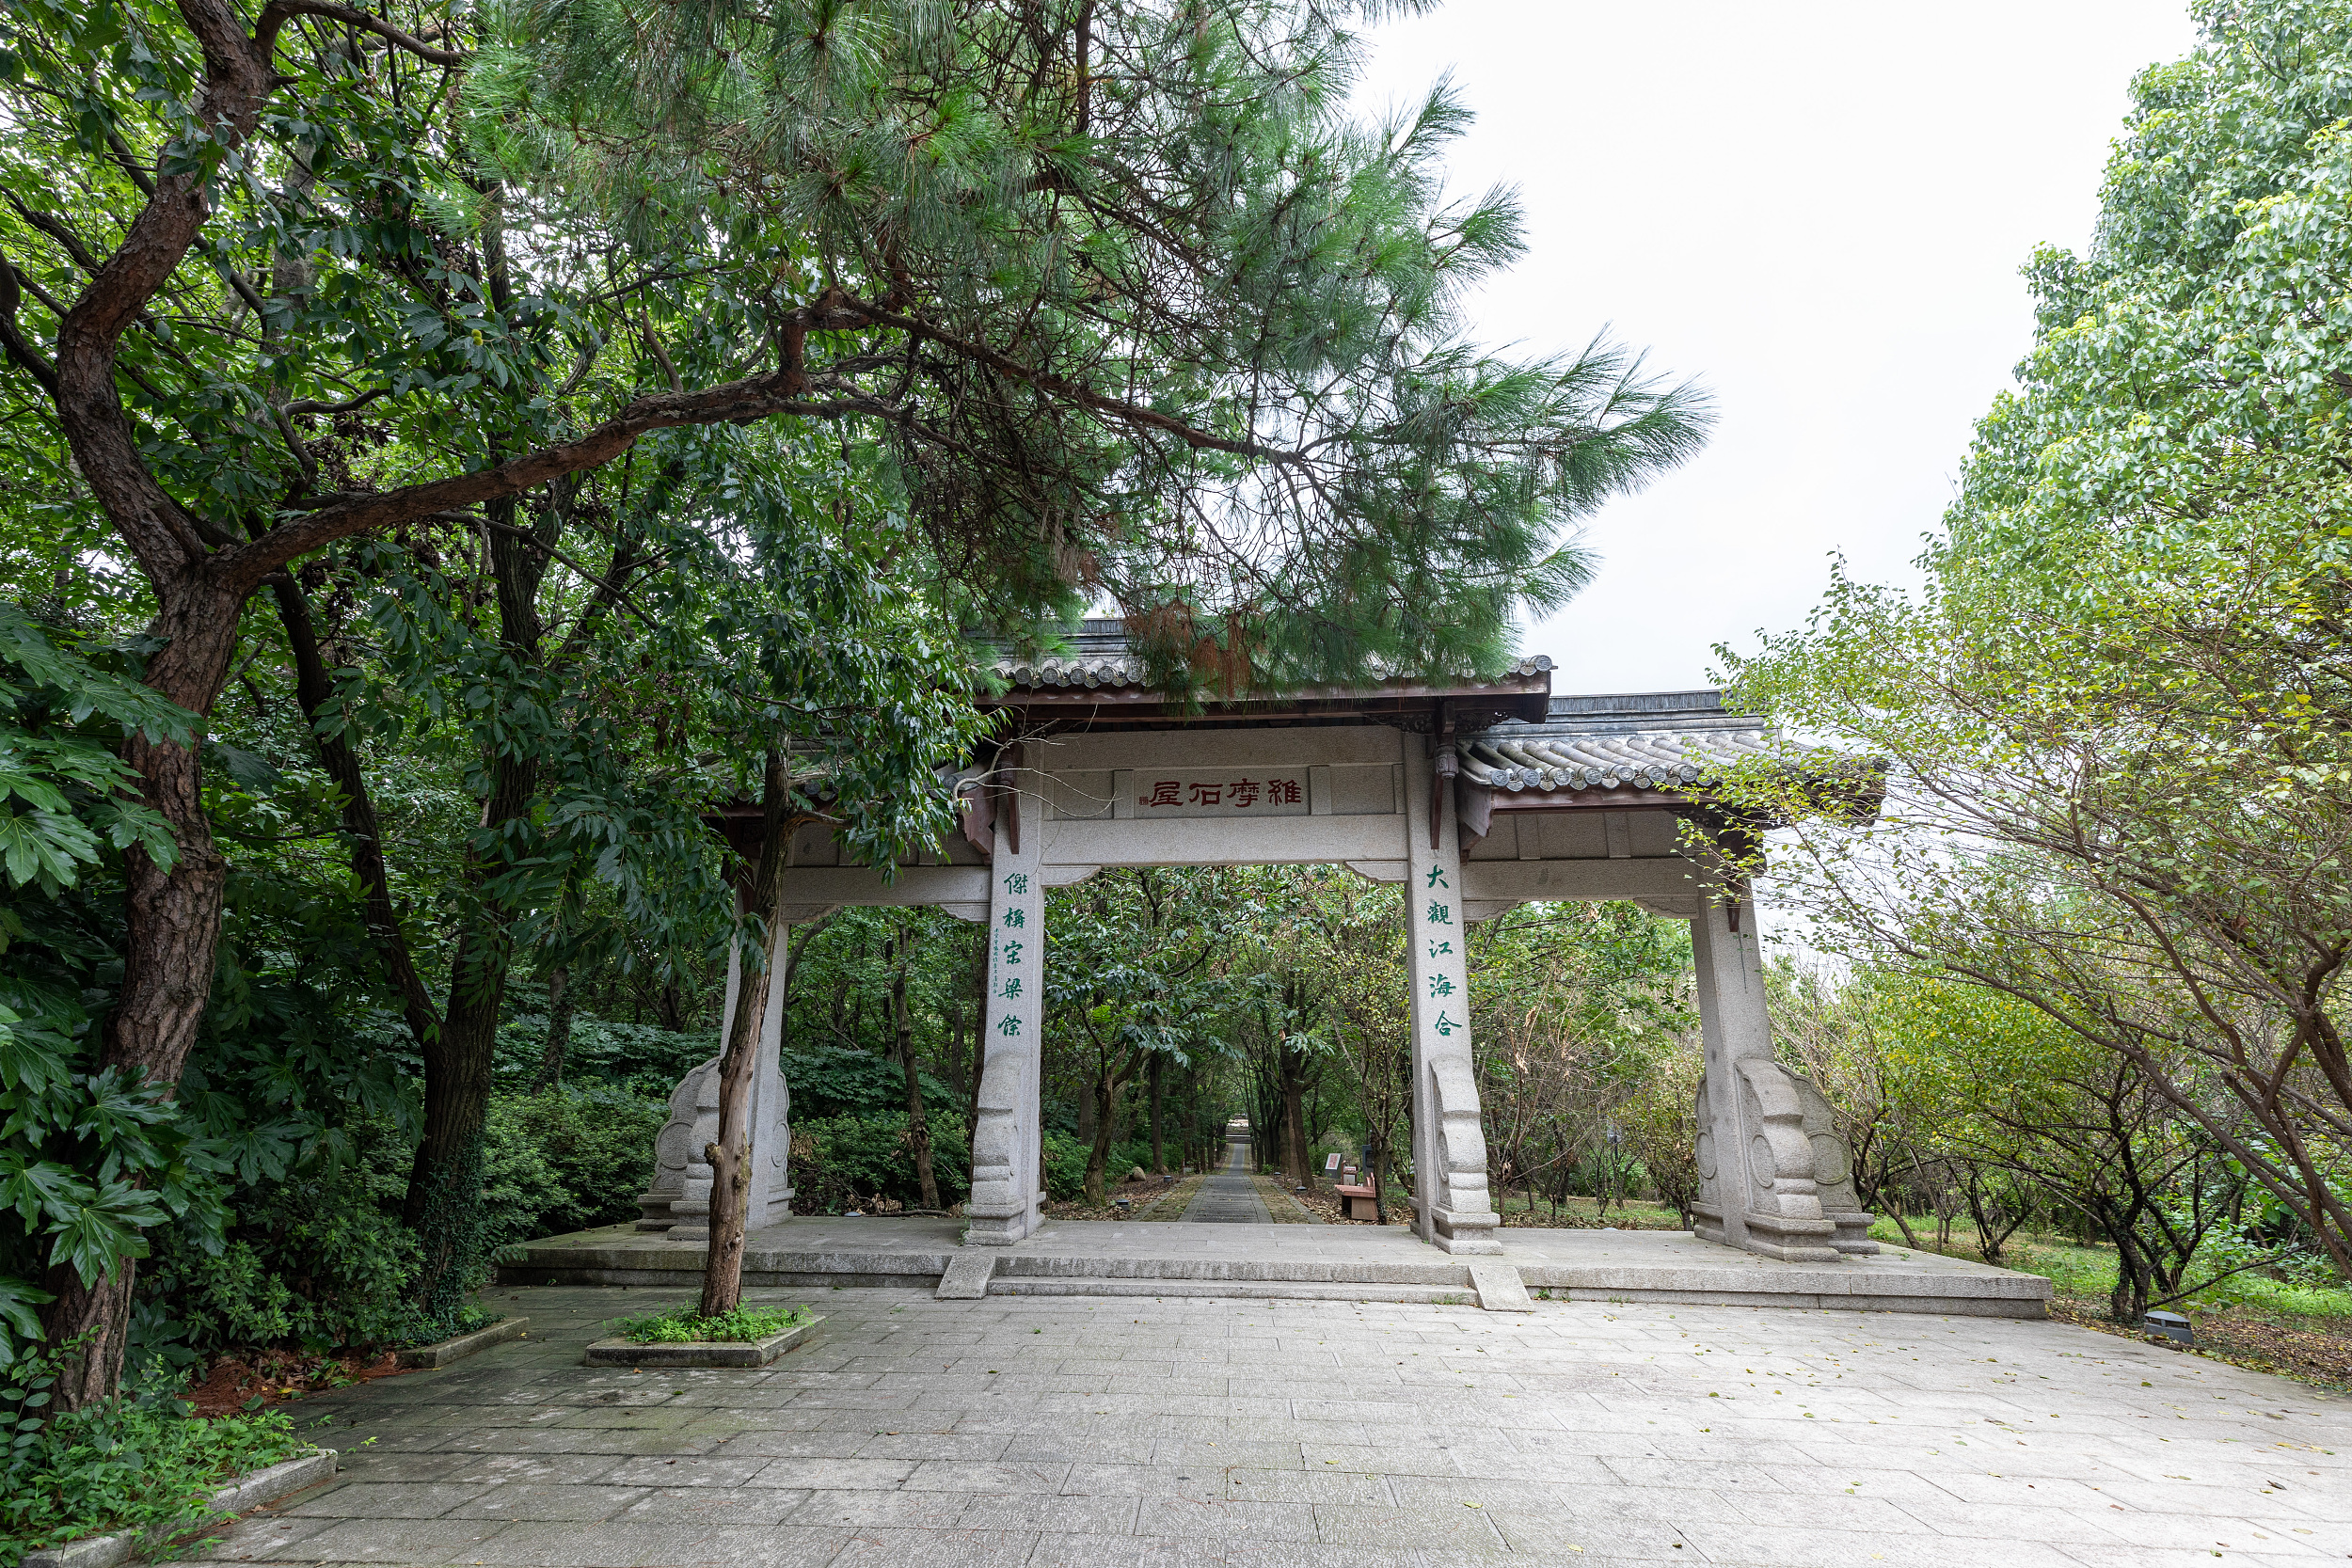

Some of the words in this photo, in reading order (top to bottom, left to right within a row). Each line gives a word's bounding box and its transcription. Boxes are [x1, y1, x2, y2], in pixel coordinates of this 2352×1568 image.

[1426, 863, 1463, 1037] 大觀江海合
